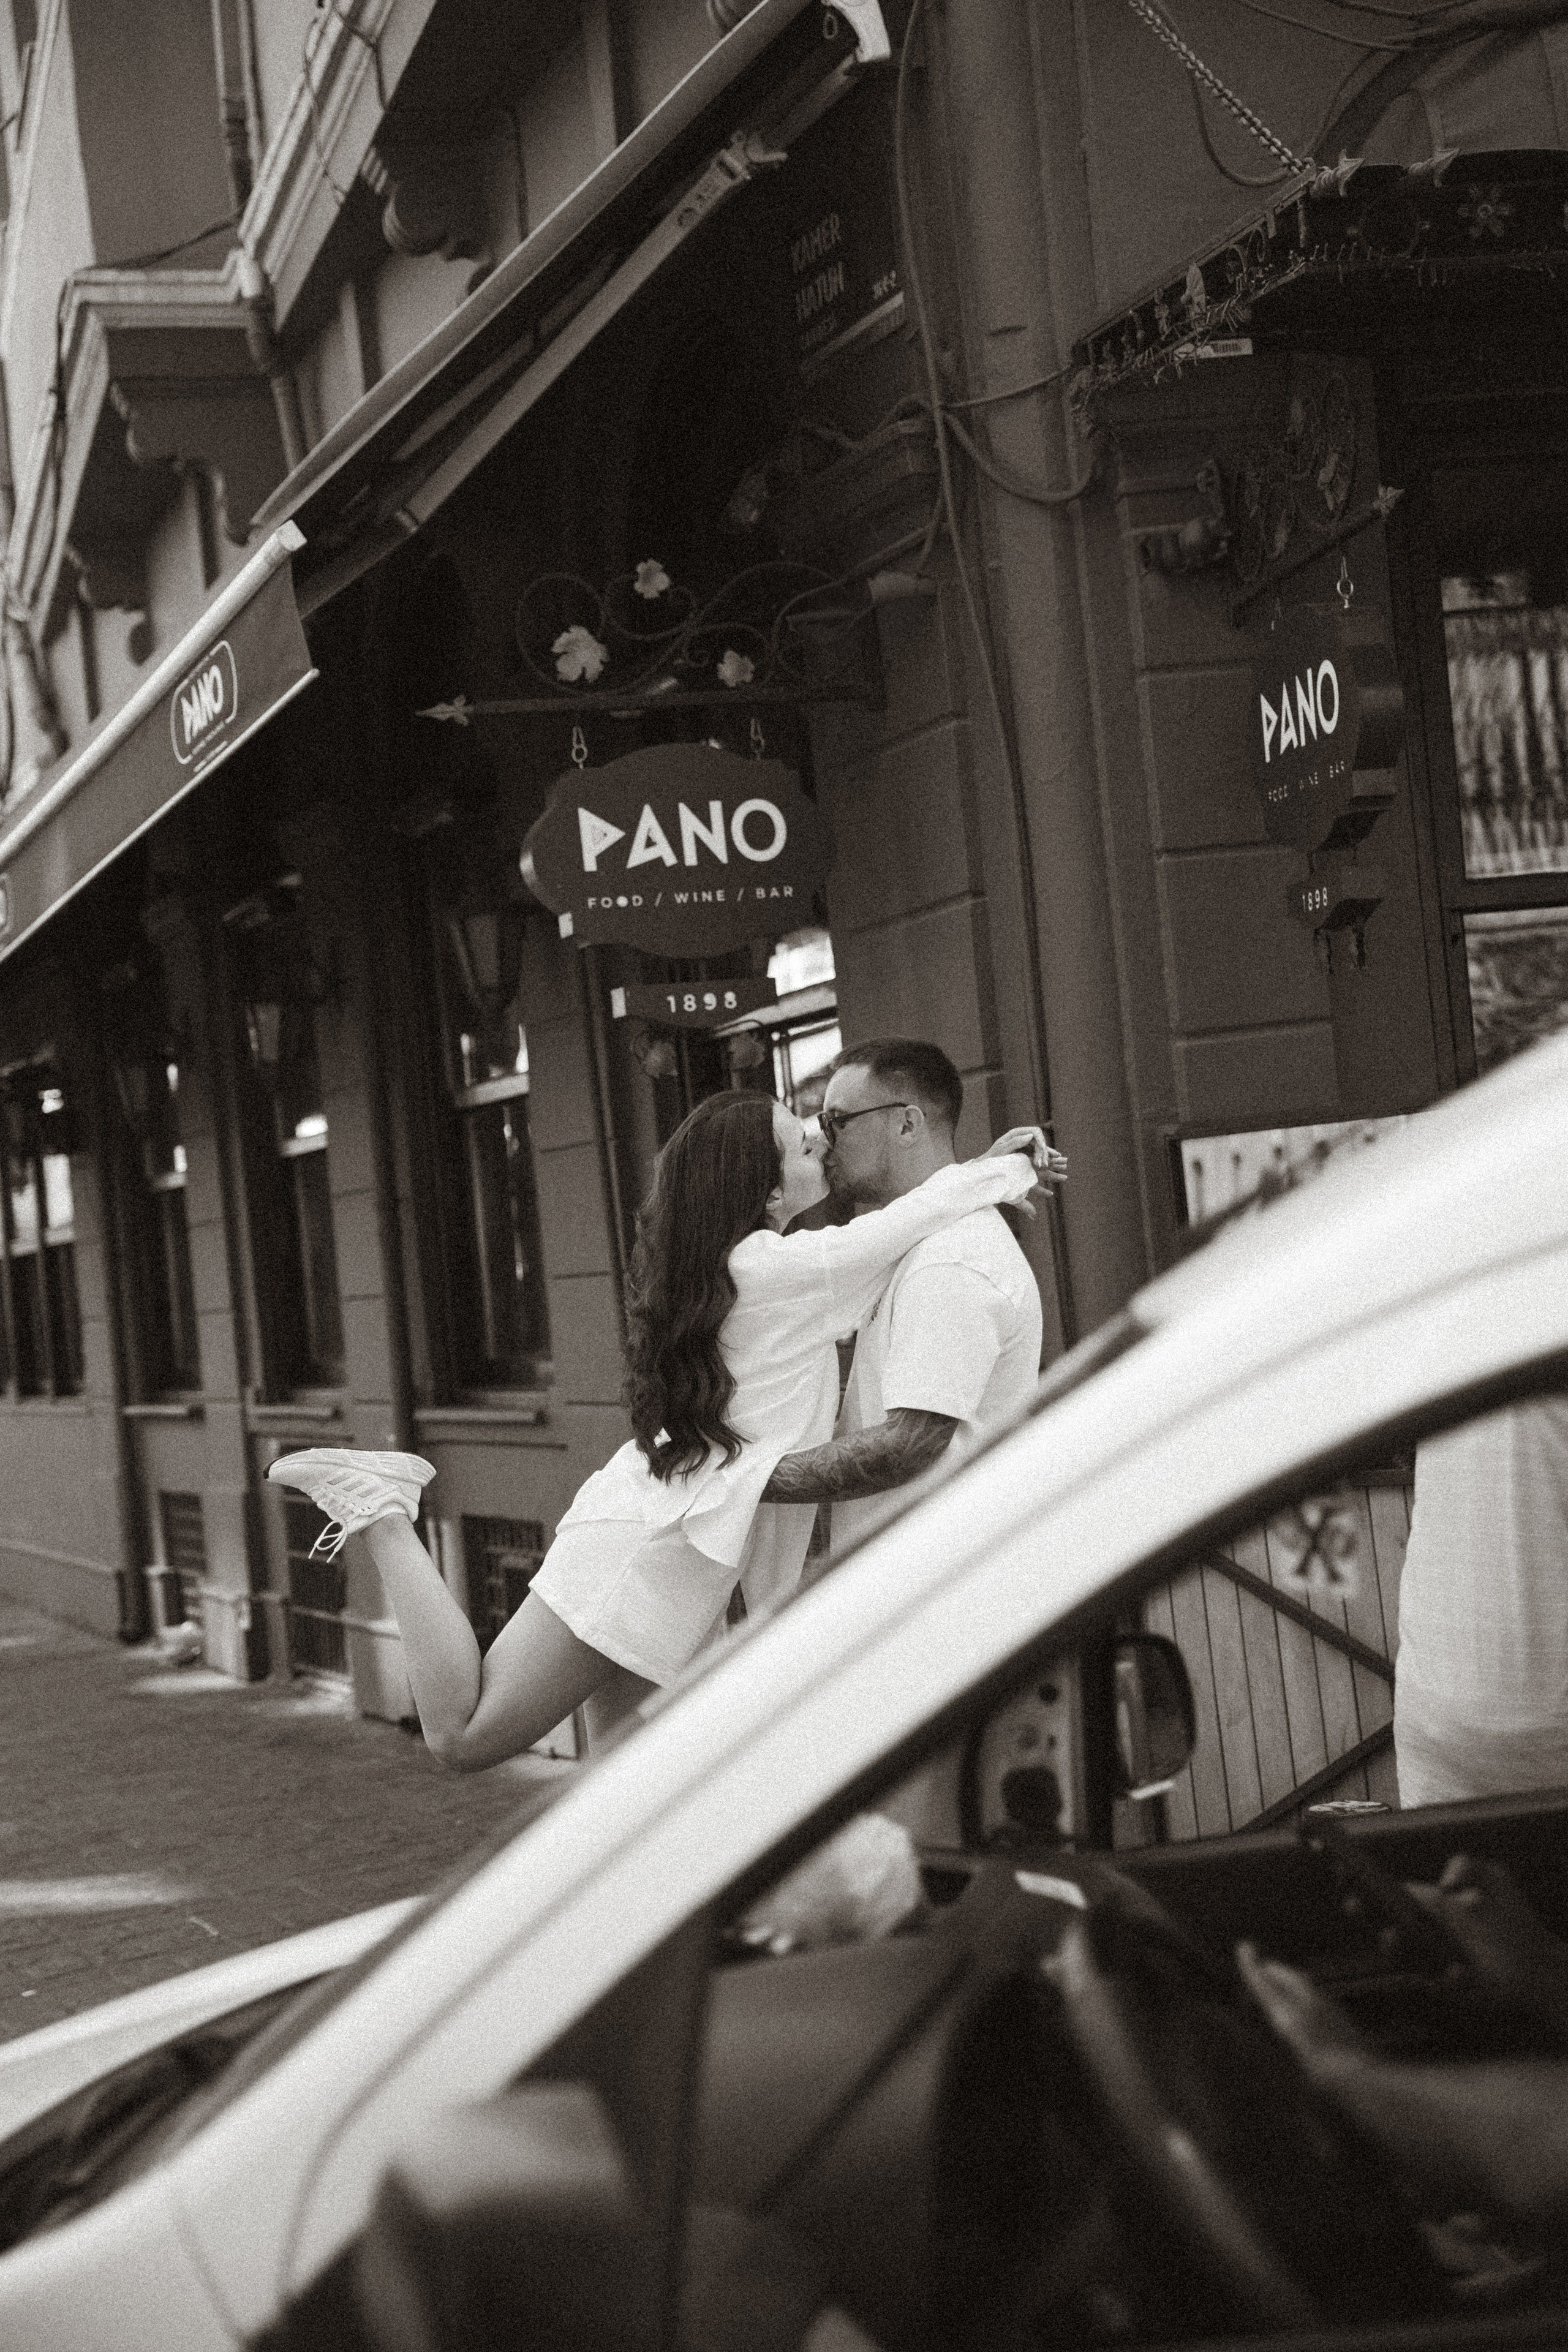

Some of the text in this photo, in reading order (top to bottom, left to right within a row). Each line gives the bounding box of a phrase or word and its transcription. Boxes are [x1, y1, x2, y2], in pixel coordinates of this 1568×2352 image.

[1259, 659, 1340, 764] PANO
[577, 798, 787, 872] PANO
[587, 895, 644, 909] FOOD
[674, 889, 726, 905] WINE
[756, 886, 794, 900] BAR
[1302, 886, 1328, 913] 1898
[666, 990, 737, 1014] 1898
